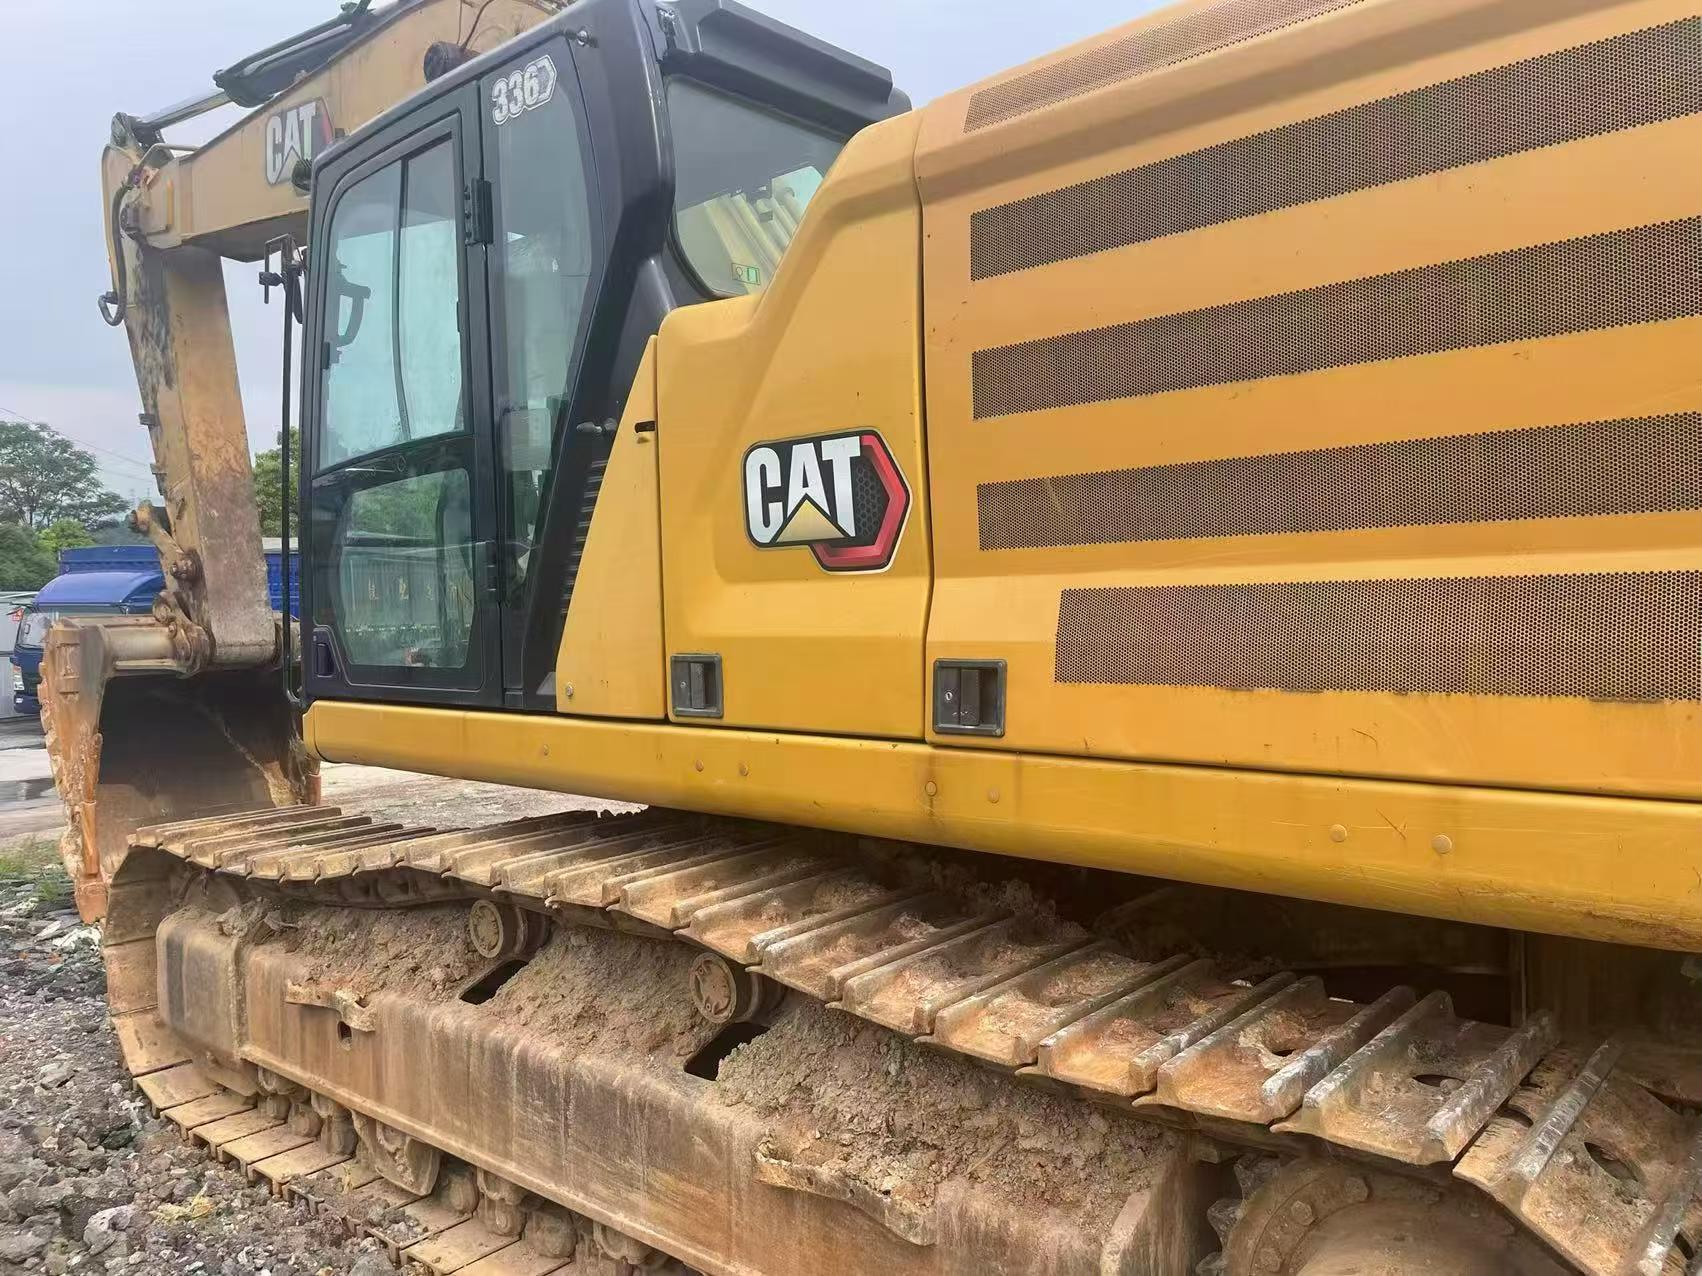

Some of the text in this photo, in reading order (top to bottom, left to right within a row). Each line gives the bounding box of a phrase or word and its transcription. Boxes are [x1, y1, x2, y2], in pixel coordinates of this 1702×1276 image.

[493, 64, 540, 122] 336
[266, 102, 317, 184] CAT
[746, 436, 860, 543] CAT
